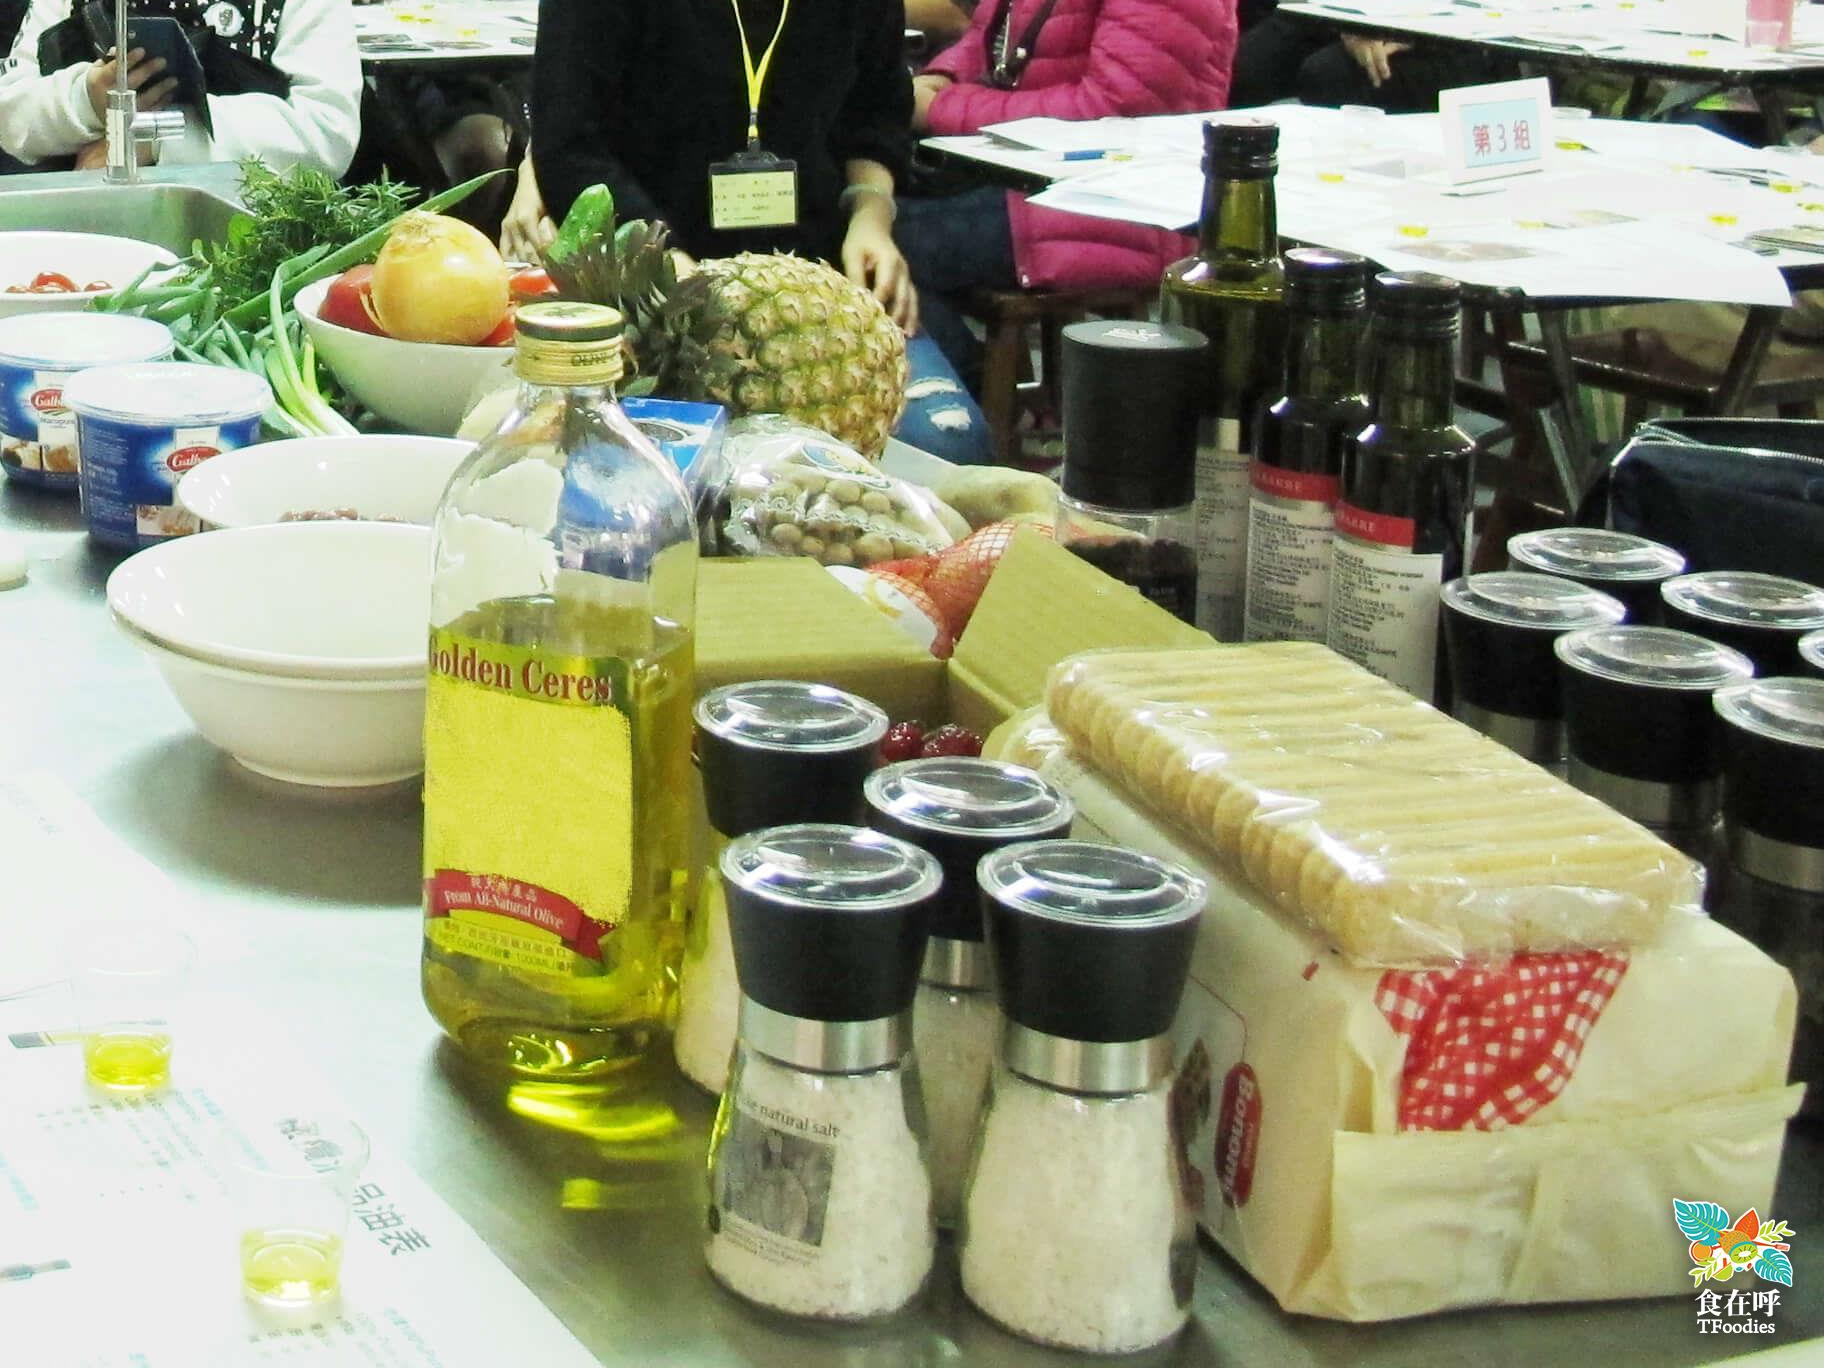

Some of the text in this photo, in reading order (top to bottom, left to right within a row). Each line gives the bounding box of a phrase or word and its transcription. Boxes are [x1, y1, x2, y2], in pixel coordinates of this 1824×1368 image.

[522, 658, 612, 702] Ceres
[444, 889, 472, 904] From
[533, 907, 565, 929] Olive
[759, 1104, 809, 1131] natural
[812, 1122, 841, 1139] salt
